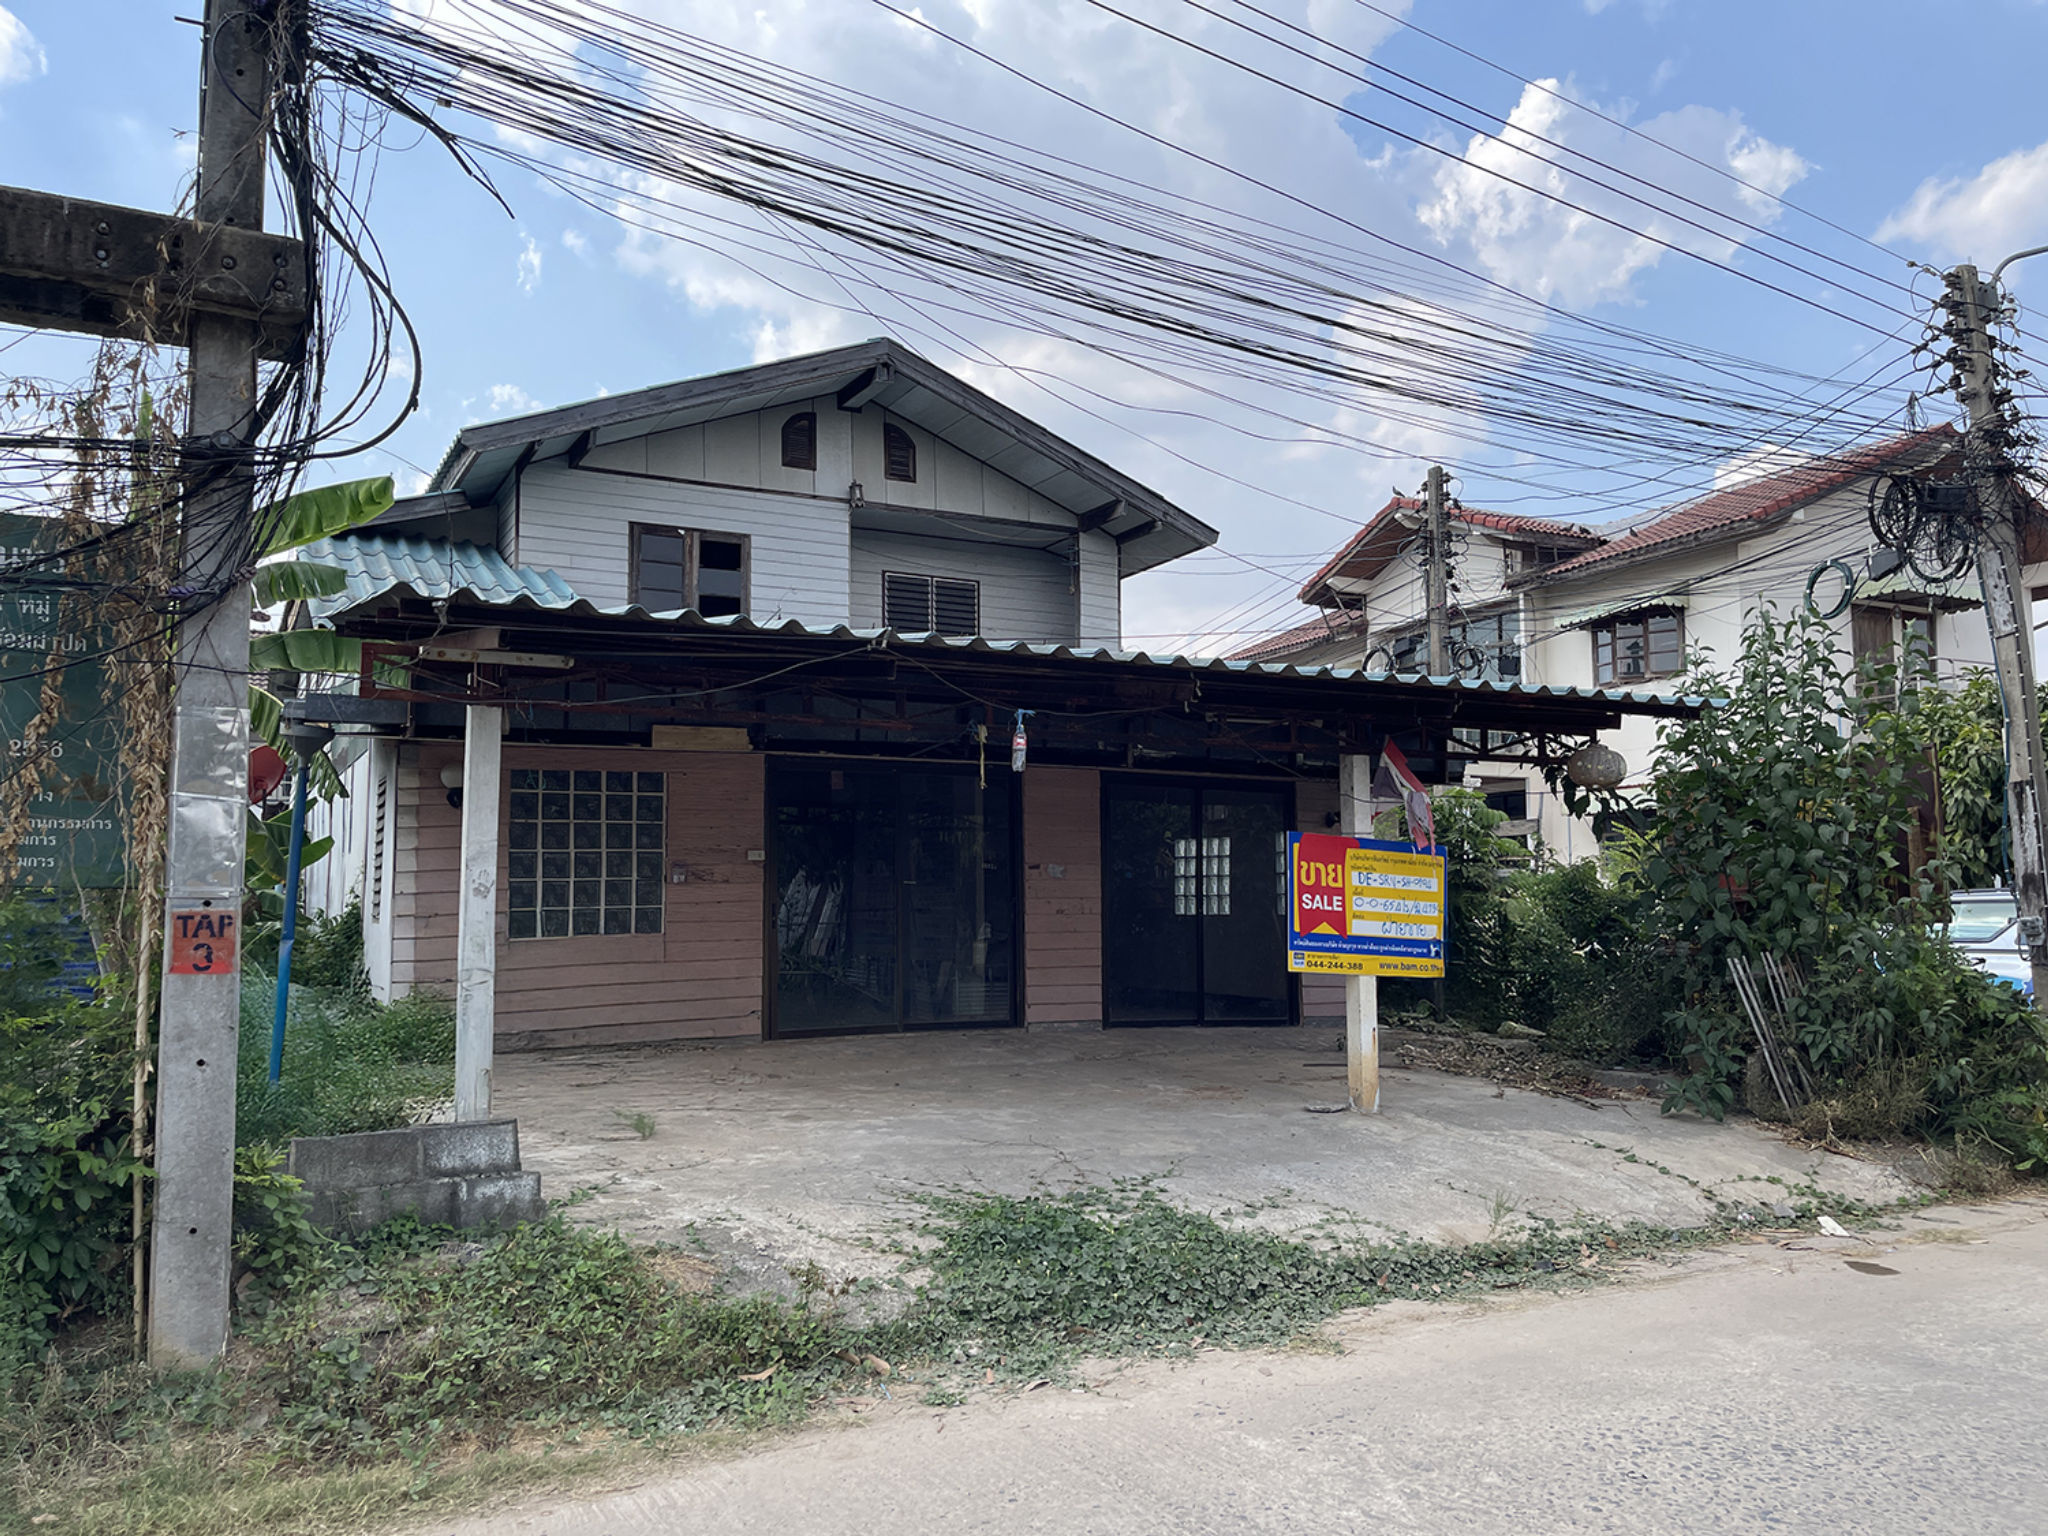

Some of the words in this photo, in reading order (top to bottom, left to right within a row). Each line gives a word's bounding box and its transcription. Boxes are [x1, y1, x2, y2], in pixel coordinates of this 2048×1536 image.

[19, 595, 50, 623] หมู่
[1301, 861, 1343, 888] ขาย
[1302, 893, 1343, 912] SALE
[176, 914, 234, 938] TAP
[192, 943, 213, 972] 3
[1306, 960, 1363, 970] 044-244-388
